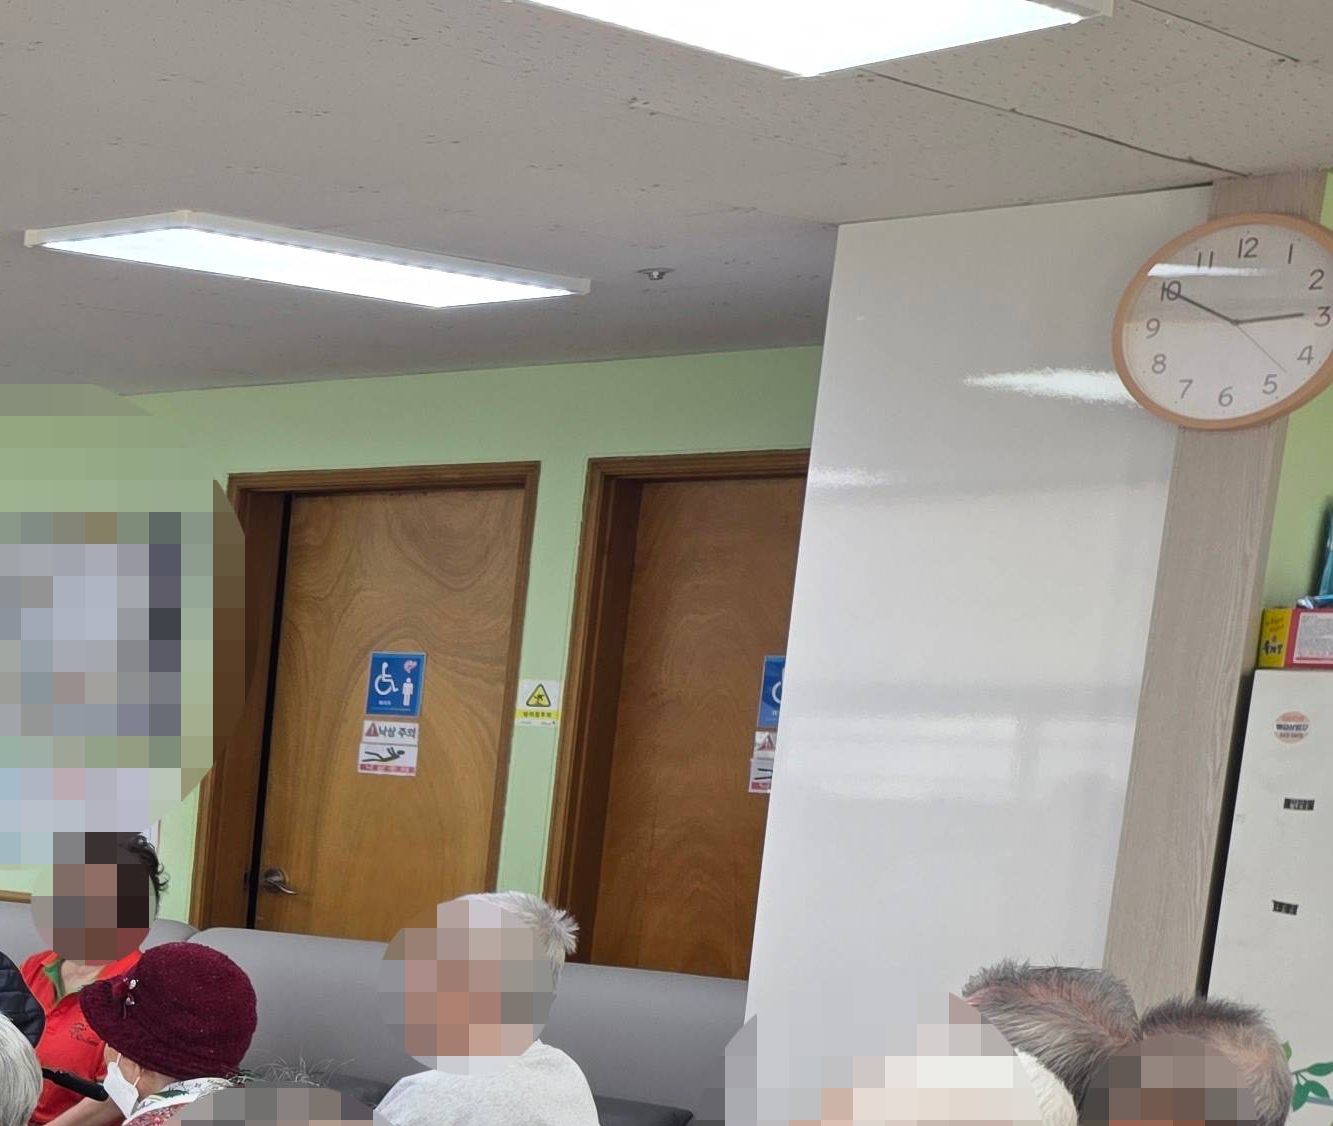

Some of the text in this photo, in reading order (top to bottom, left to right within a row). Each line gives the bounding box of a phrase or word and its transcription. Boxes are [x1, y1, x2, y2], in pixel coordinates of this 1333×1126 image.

[1238, 237, 1259, 259] 12
[1288, 244, 1294, 264] 1
[1197, 252, 1214, 269] 11
[1309, 270, 1324, 290] 2
[1161, 281, 1182, 302] 10
[1315, 306, 1331, 327] 3
[1146, 319, 1160, 339] 9
[1152, 354, 1167, 374] 8
[1297, 345, 1314, 365] 4
[1180, 379, 1193, 399] 7
[1262, 374, 1277, 395] 5
[1219, 387, 1233, 407] 6
[378, 725, 416, 739] 낙상 주의
